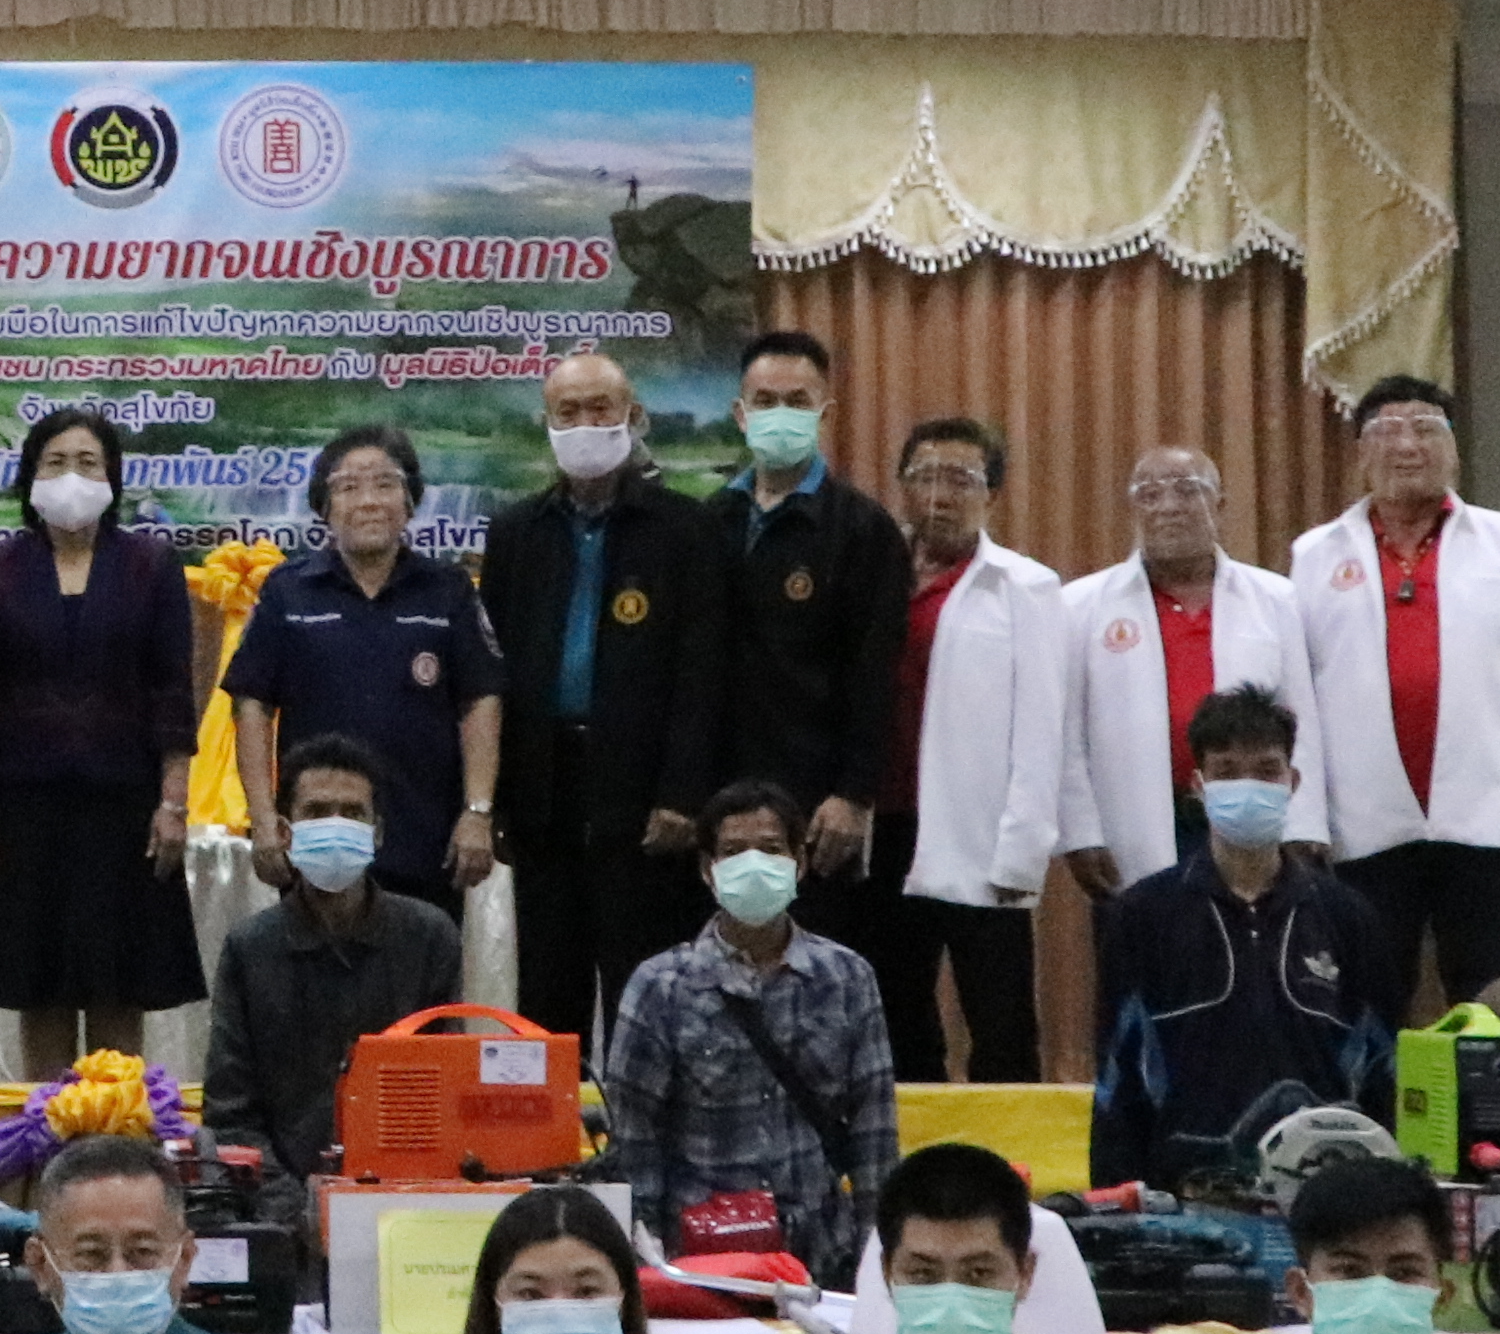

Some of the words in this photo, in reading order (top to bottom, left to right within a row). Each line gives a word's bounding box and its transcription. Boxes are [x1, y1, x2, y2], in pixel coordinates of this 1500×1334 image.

[52, 347, 323, 379] กระทรวงมหาดไทย
[330, 351, 372, 377] กับ
